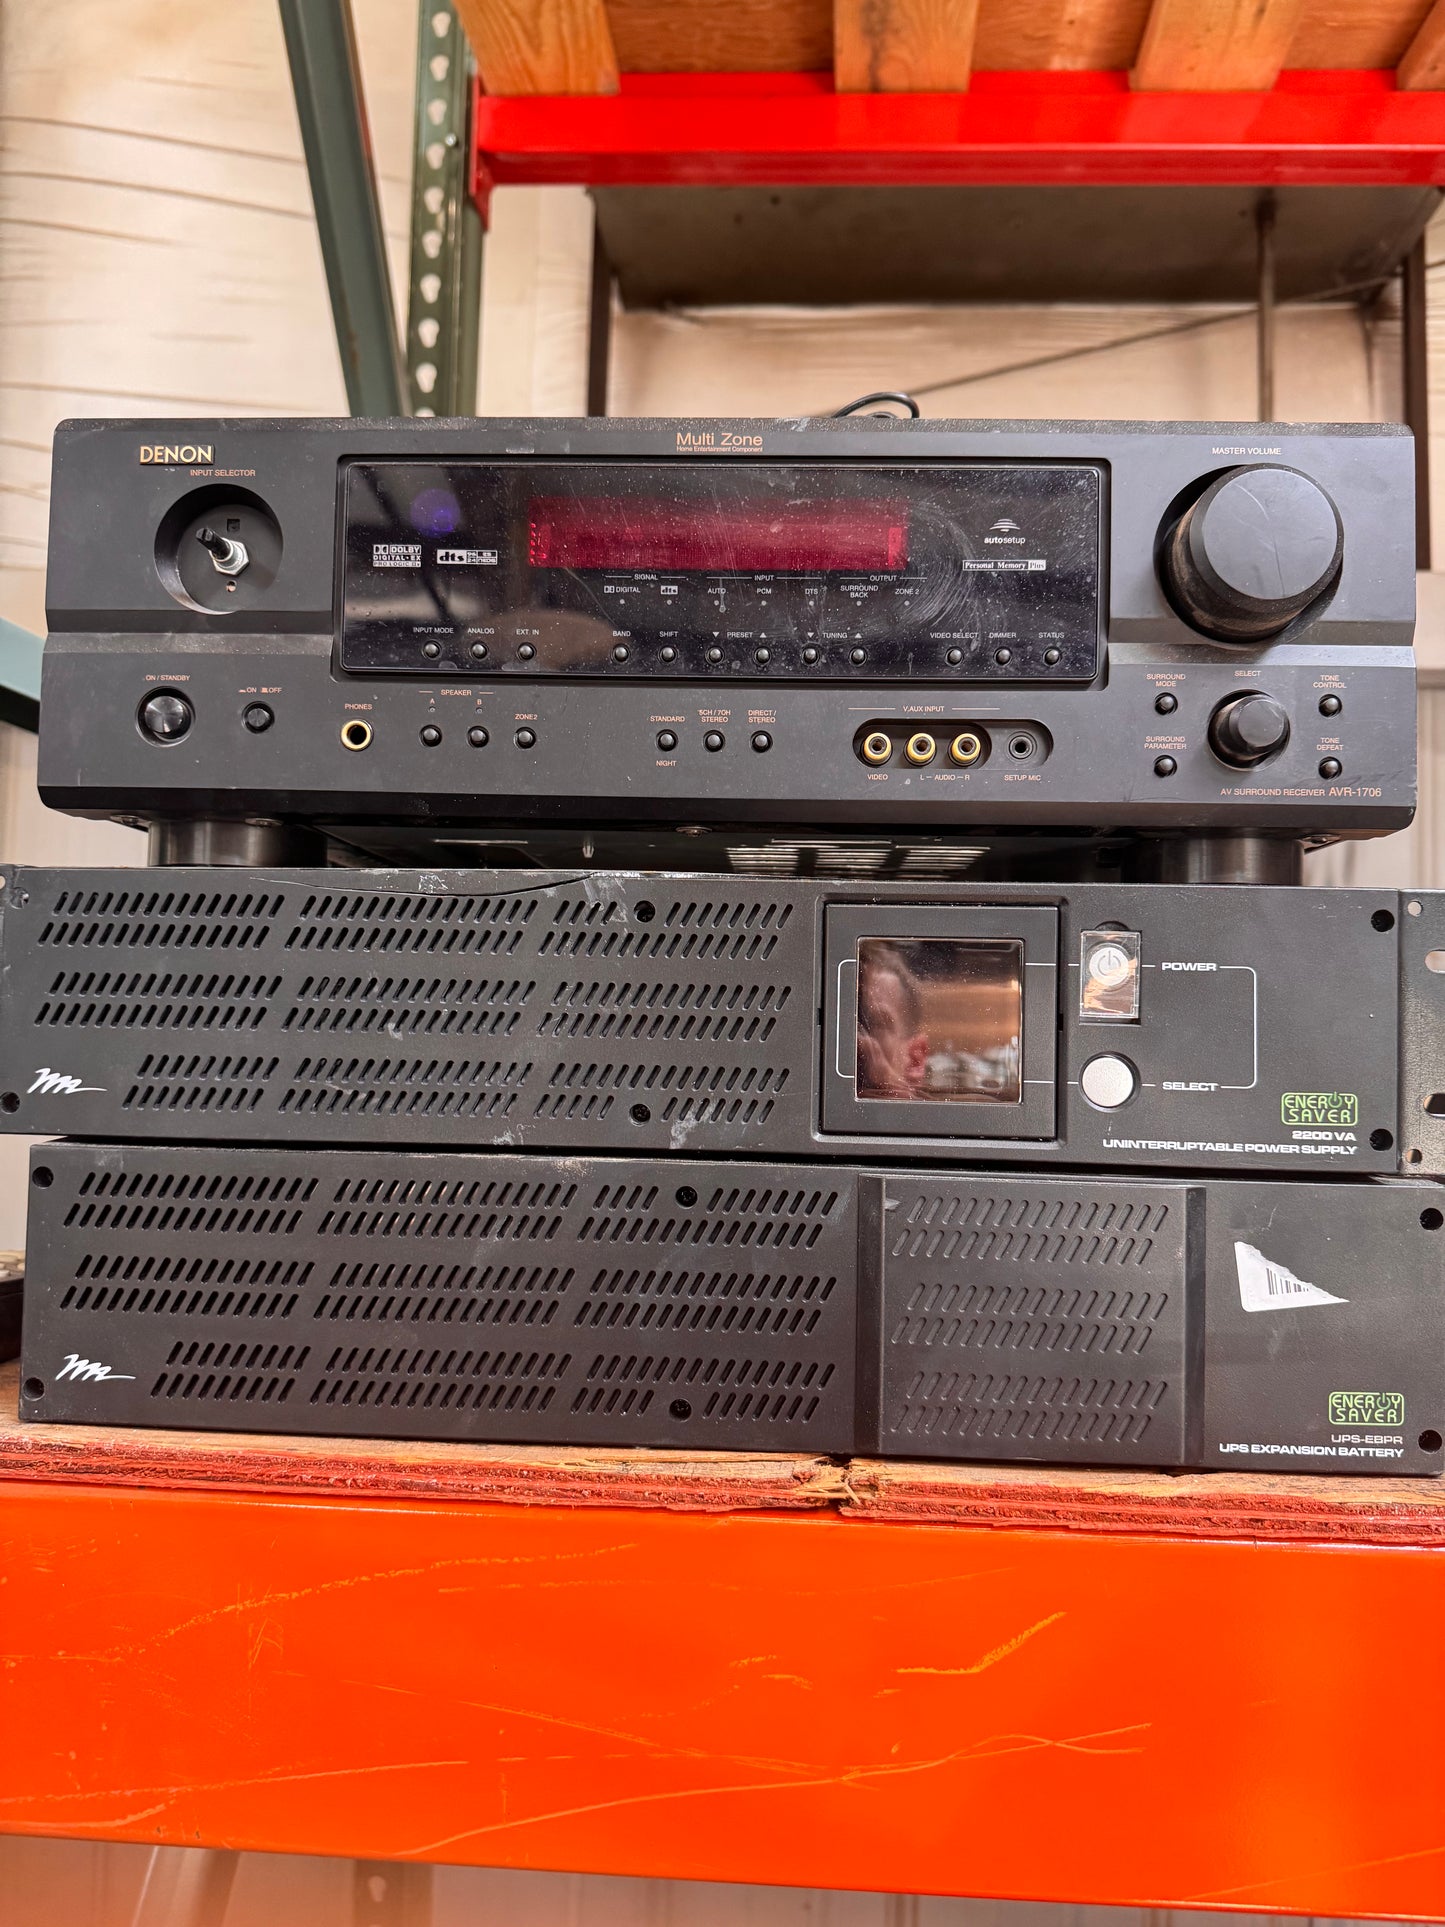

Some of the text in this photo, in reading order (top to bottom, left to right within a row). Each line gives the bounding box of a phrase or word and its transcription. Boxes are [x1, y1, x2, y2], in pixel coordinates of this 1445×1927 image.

[676, 432, 763, 446] Multi Zone
[139, 445, 213, 464] DENON
[1212, 447, 1282, 455] MASTER VOLUME
[190, 469, 257, 477] INPUT SELECTOR
[391, 546, 420, 554] DOLBY
[439, 551, 465, 562] dts
[965, 561, 1045, 570] Personal Memory Plus
[467, 627, 495, 635] ANALOG
[440, 689, 472, 697] SPEAKER
[1144, 742, 1187, 750] PARAMETER
[1220, 787, 1382, 797] AV SURROUND RECEIVER AVR-1706
[1161, 962, 1217, 971] POWER
[1162, 1082, 1219, 1092] SELECT
[1288, 1108, 1351, 1123] SAVER
[1292, 1130, 1357, 1142] 2200 VA
[1102, 1138, 1358, 1155] UNINTERRUPTABLE POWER SUPPLY
[1335, 1408, 1398, 1423] SAVER
[1331, 1434, 1403, 1444] UPS-EBPR
[1219, 1443, 1404, 1458] UPS EXPANSION BATTERY
